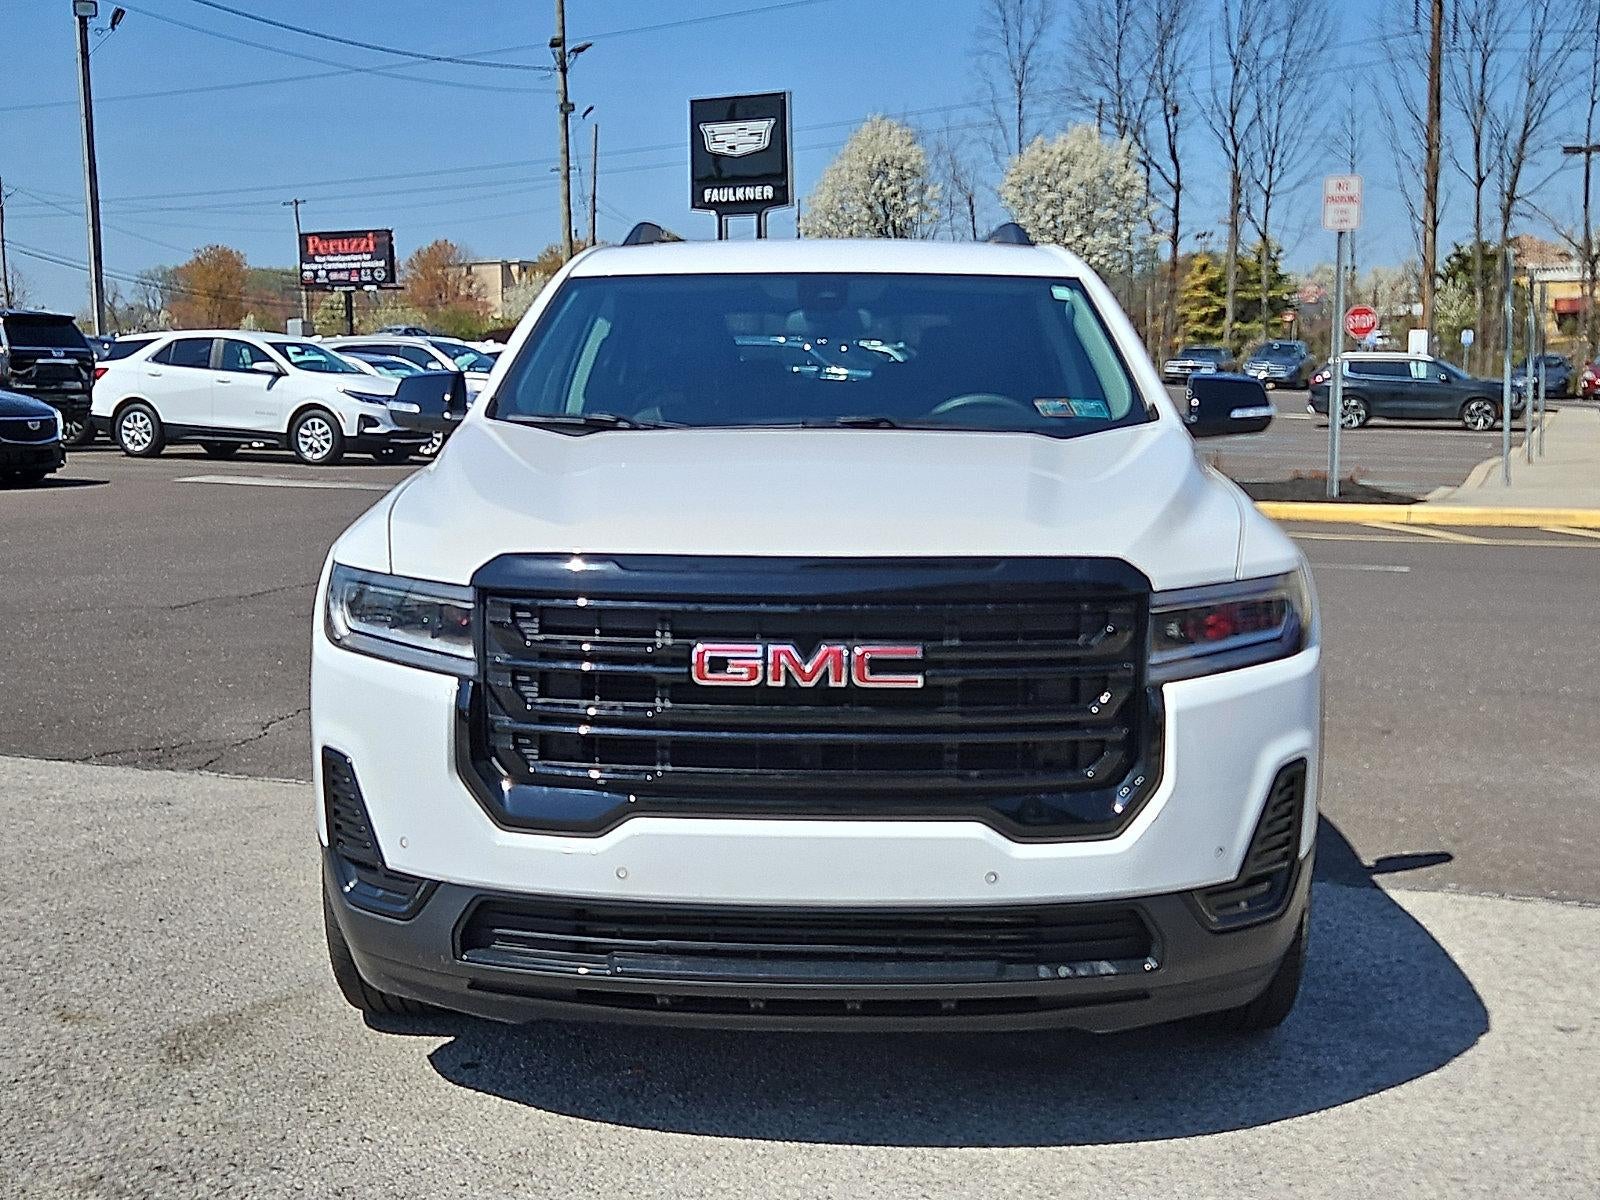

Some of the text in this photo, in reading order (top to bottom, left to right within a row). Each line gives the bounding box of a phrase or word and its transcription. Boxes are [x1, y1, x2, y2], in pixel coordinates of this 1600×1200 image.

[704, 185, 774, 203] FAULKNER
[307, 232, 375, 255] Peruzzi
[1346, 314, 1376, 329] STOP
[692, 642, 924, 688] GMC
